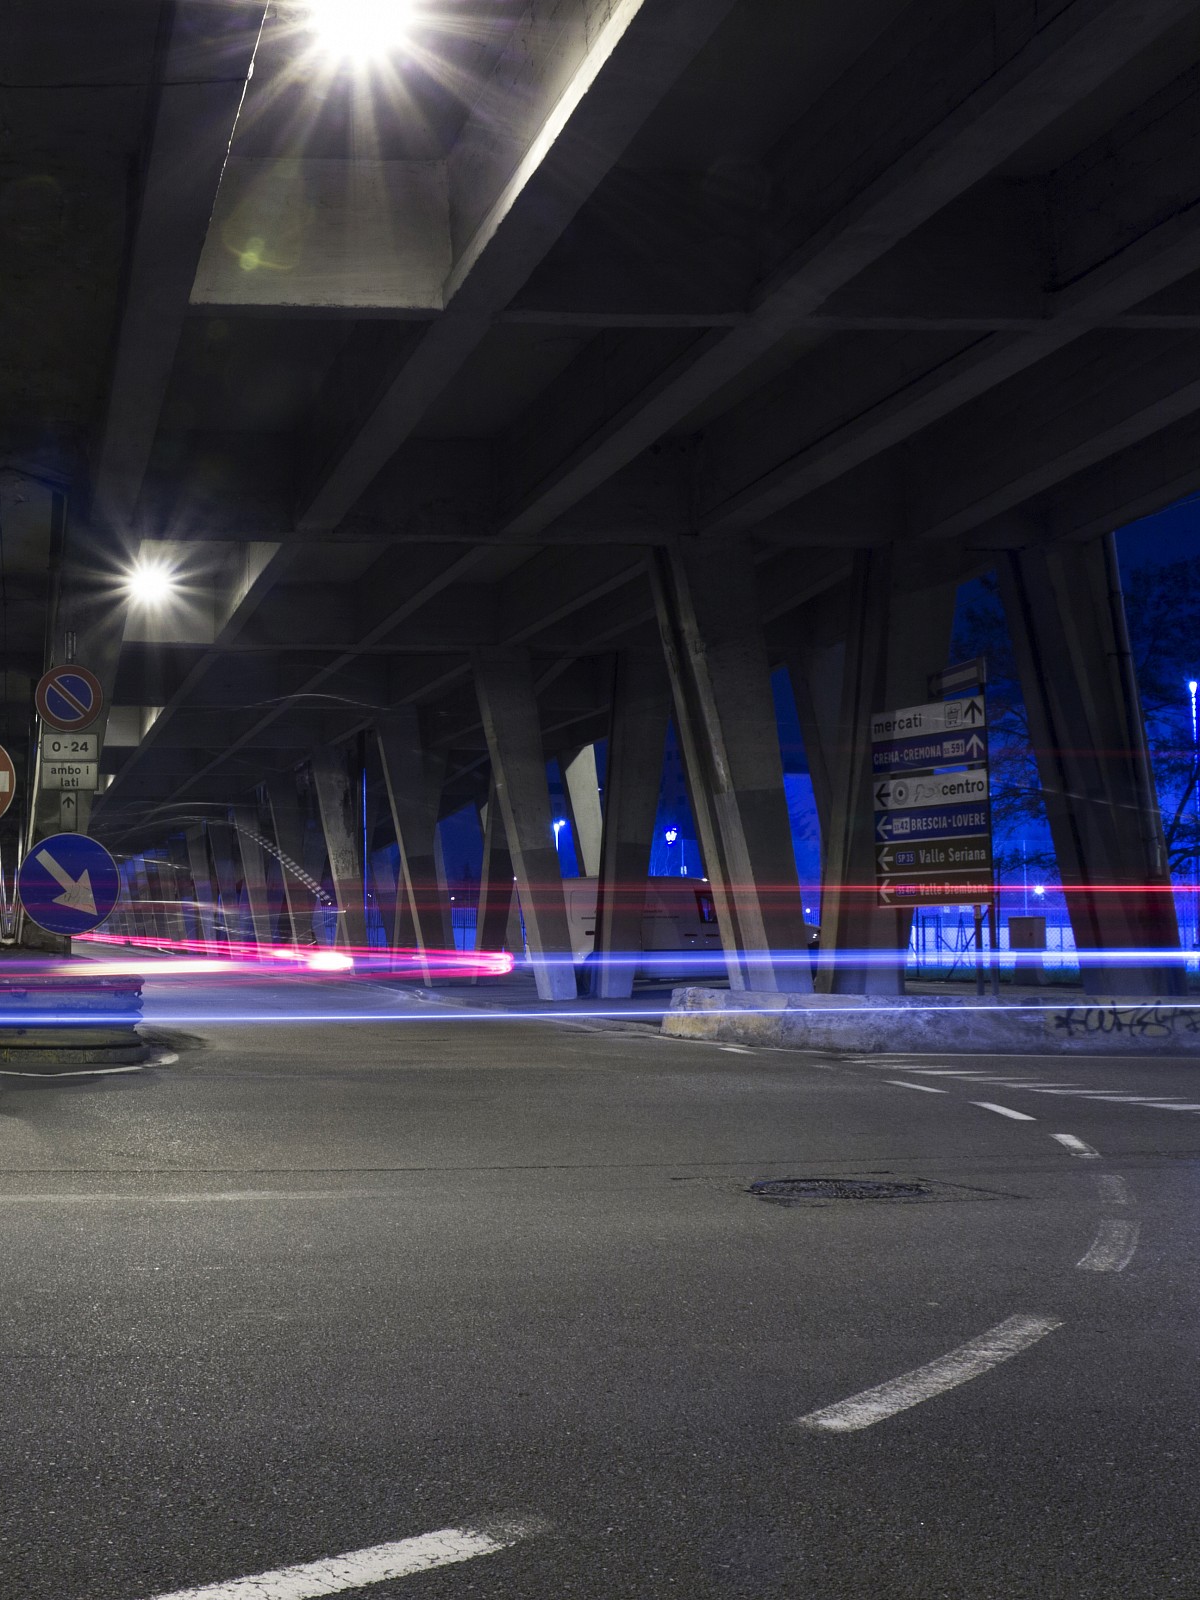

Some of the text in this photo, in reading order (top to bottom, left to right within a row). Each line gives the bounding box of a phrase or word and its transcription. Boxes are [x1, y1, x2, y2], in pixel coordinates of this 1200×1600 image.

[874, 713, 922, 734] mercati
[951, 742, 963, 754] 591
[51, 765, 89, 775] ambo i
[60, 777, 79, 787] lati
[942, 779, 985, 796] centro
[900, 820, 909, 831] 42
[919, 848, 945, 864] Valle
[948, 846, 986, 862] Seriana
[919, 882, 945, 896] Valle
[945, 880, 988, 896] Brembana
